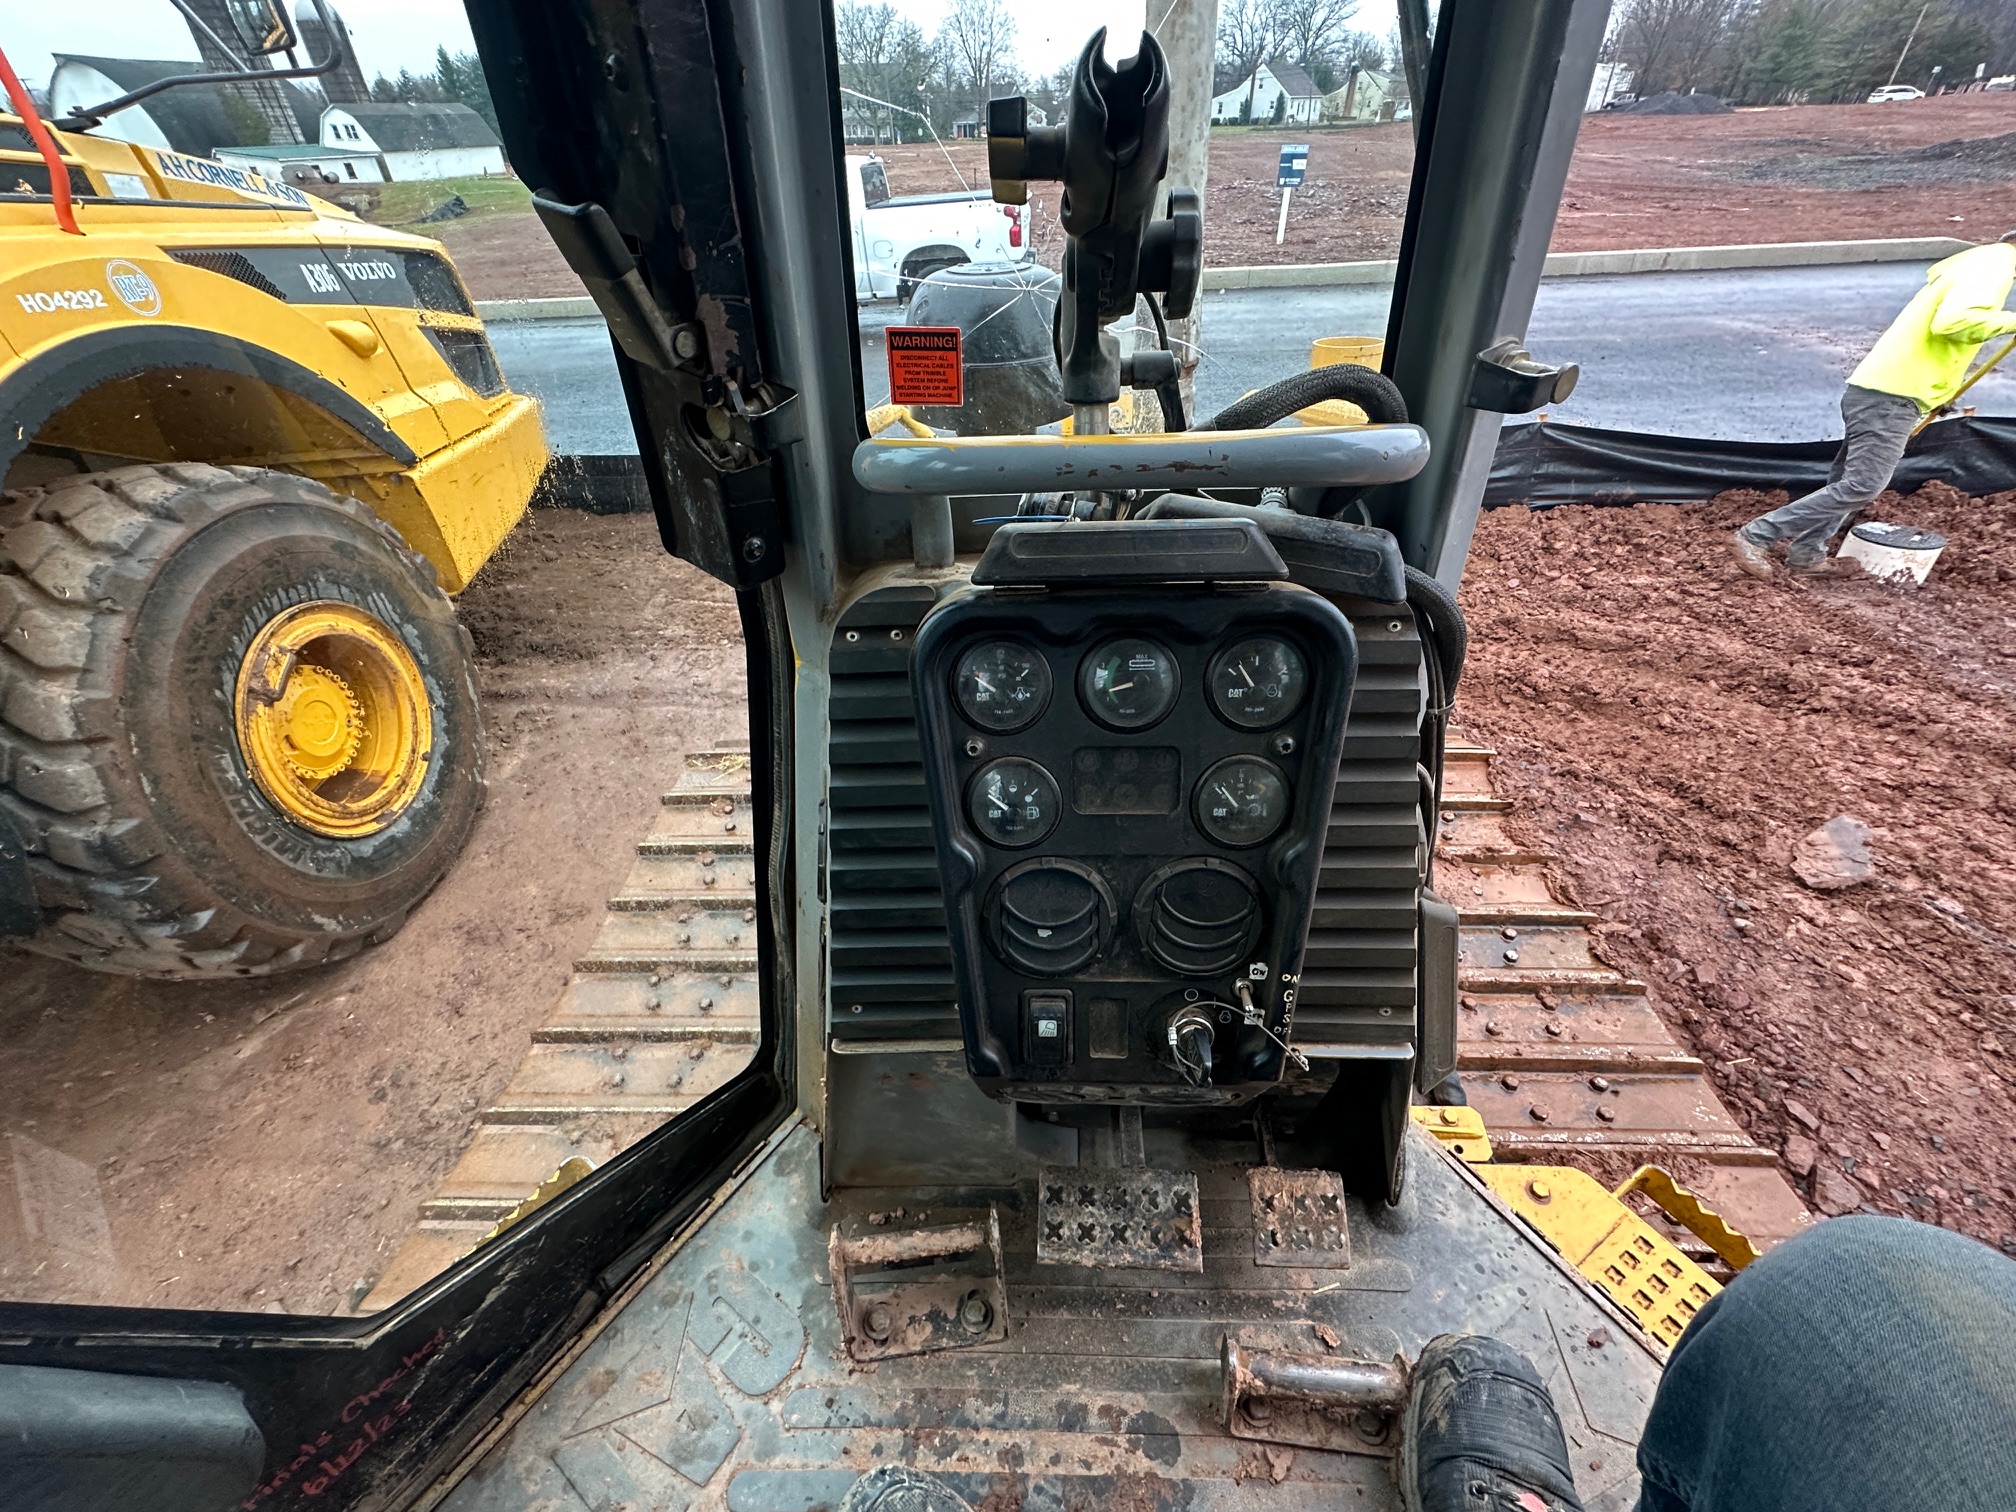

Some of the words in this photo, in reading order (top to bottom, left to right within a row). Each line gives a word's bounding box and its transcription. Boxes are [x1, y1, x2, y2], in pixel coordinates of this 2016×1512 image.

[336, 262, 396, 280] VOLVO
[891, 336, 956, 348] WARNING!
[976, 692, 990, 701] CAT
[1228, 688, 1244, 698] CAT
[988, 809, 1002, 818] CAT
[1213, 808, 1227, 816] CAT
[1252, 968, 1266, 976] ON
[1282, 973, 1300, 983] ON
